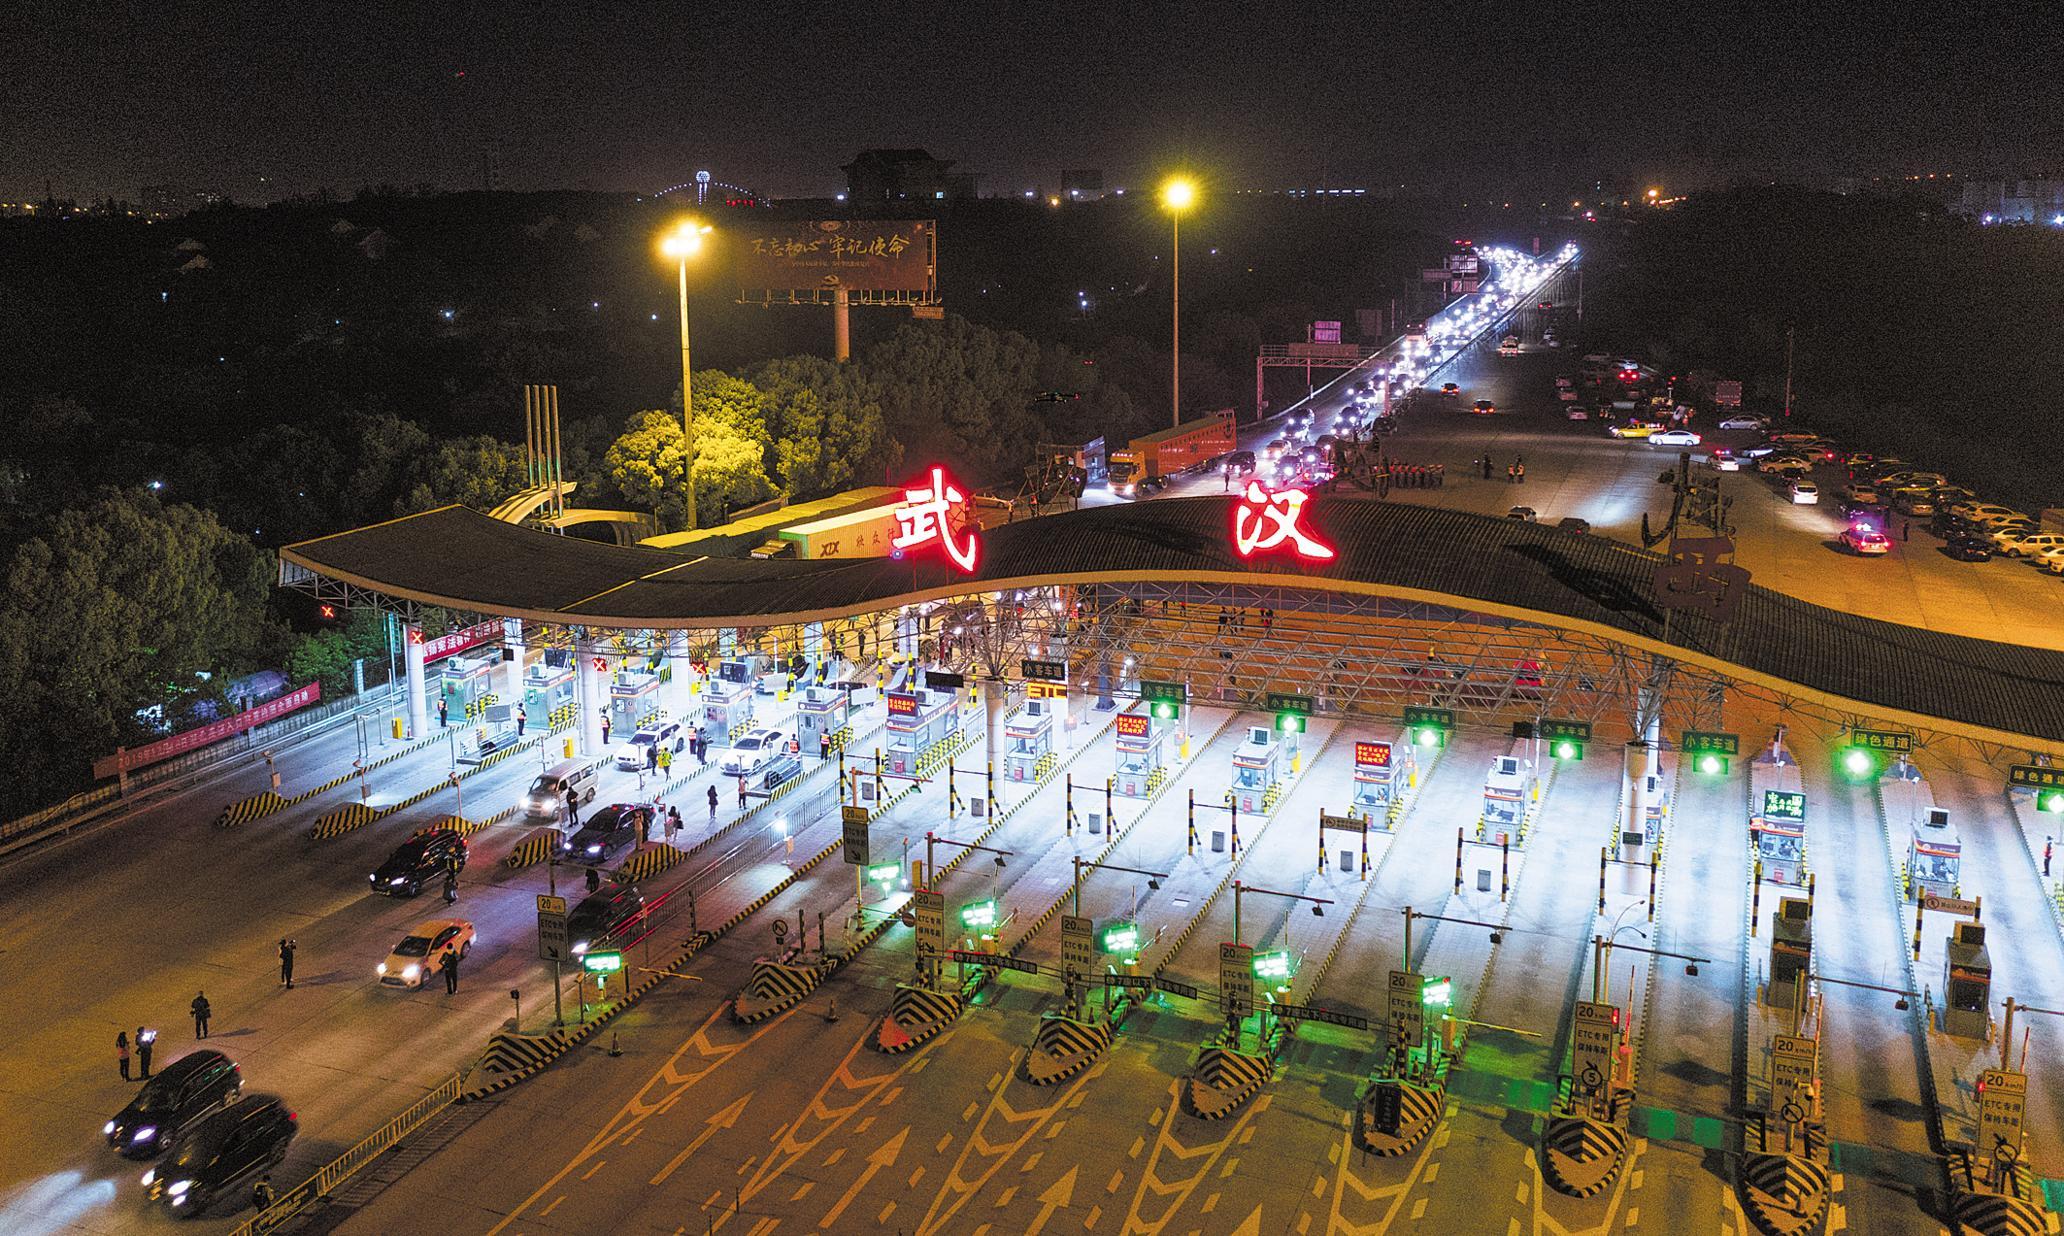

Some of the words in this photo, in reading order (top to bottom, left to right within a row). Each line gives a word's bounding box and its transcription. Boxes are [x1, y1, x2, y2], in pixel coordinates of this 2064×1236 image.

[752, 237, 824, 257] 不忘初心
[828, 234, 911, 259] 牢记使命
[891, 467, 976, 572] 武
[1236, 480, 1334, 558] 汉
[1024, 664, 1063, 677] 小客车道
[1027, 682, 1067, 699] ETC
[1685, 735, 1736, 752] 小客车道
[1856, 733, 1910, 749] 绿色通道
[541, 898, 551, 909] 20
[918, 894, 928, 905] 20
[1064, 920, 1076, 931] 20
[1222, 949, 1235, 958] 20
[1392, 976, 1405, 987] 20
[1579, 1006, 1593, 1017] 20
[1777, 1040, 1793, 1052] 20
[1589, 1072, 1596, 1083] 5
[1986, 1074, 2004, 1087] 20
